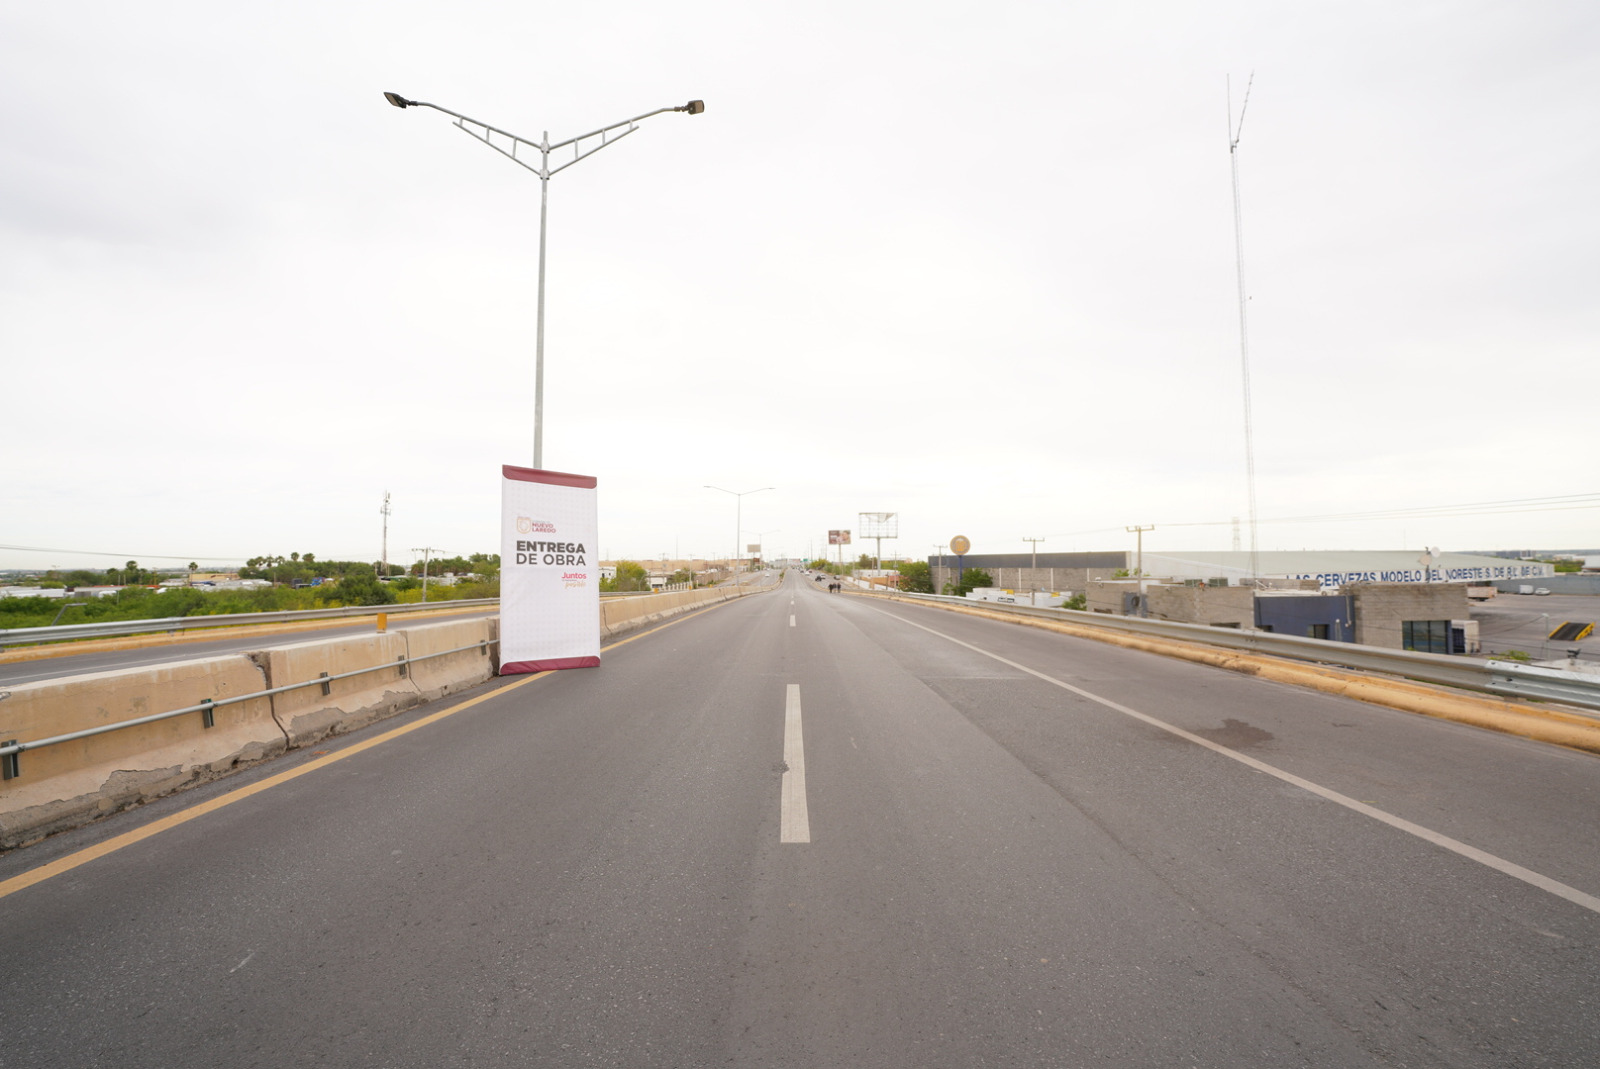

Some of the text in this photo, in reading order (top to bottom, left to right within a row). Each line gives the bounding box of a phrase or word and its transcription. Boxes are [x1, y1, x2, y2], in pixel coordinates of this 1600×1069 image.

[516, 540, 586, 554] ENTREGA
[516, 553, 586, 566] DE OBRA
[1316, 572, 1376, 587] CERVEZAS
[1381, 570, 1422, 582] MODELO
[1445, 567, 1482, 579] NORESTE
[1494, 567, 1504, 578] DE
